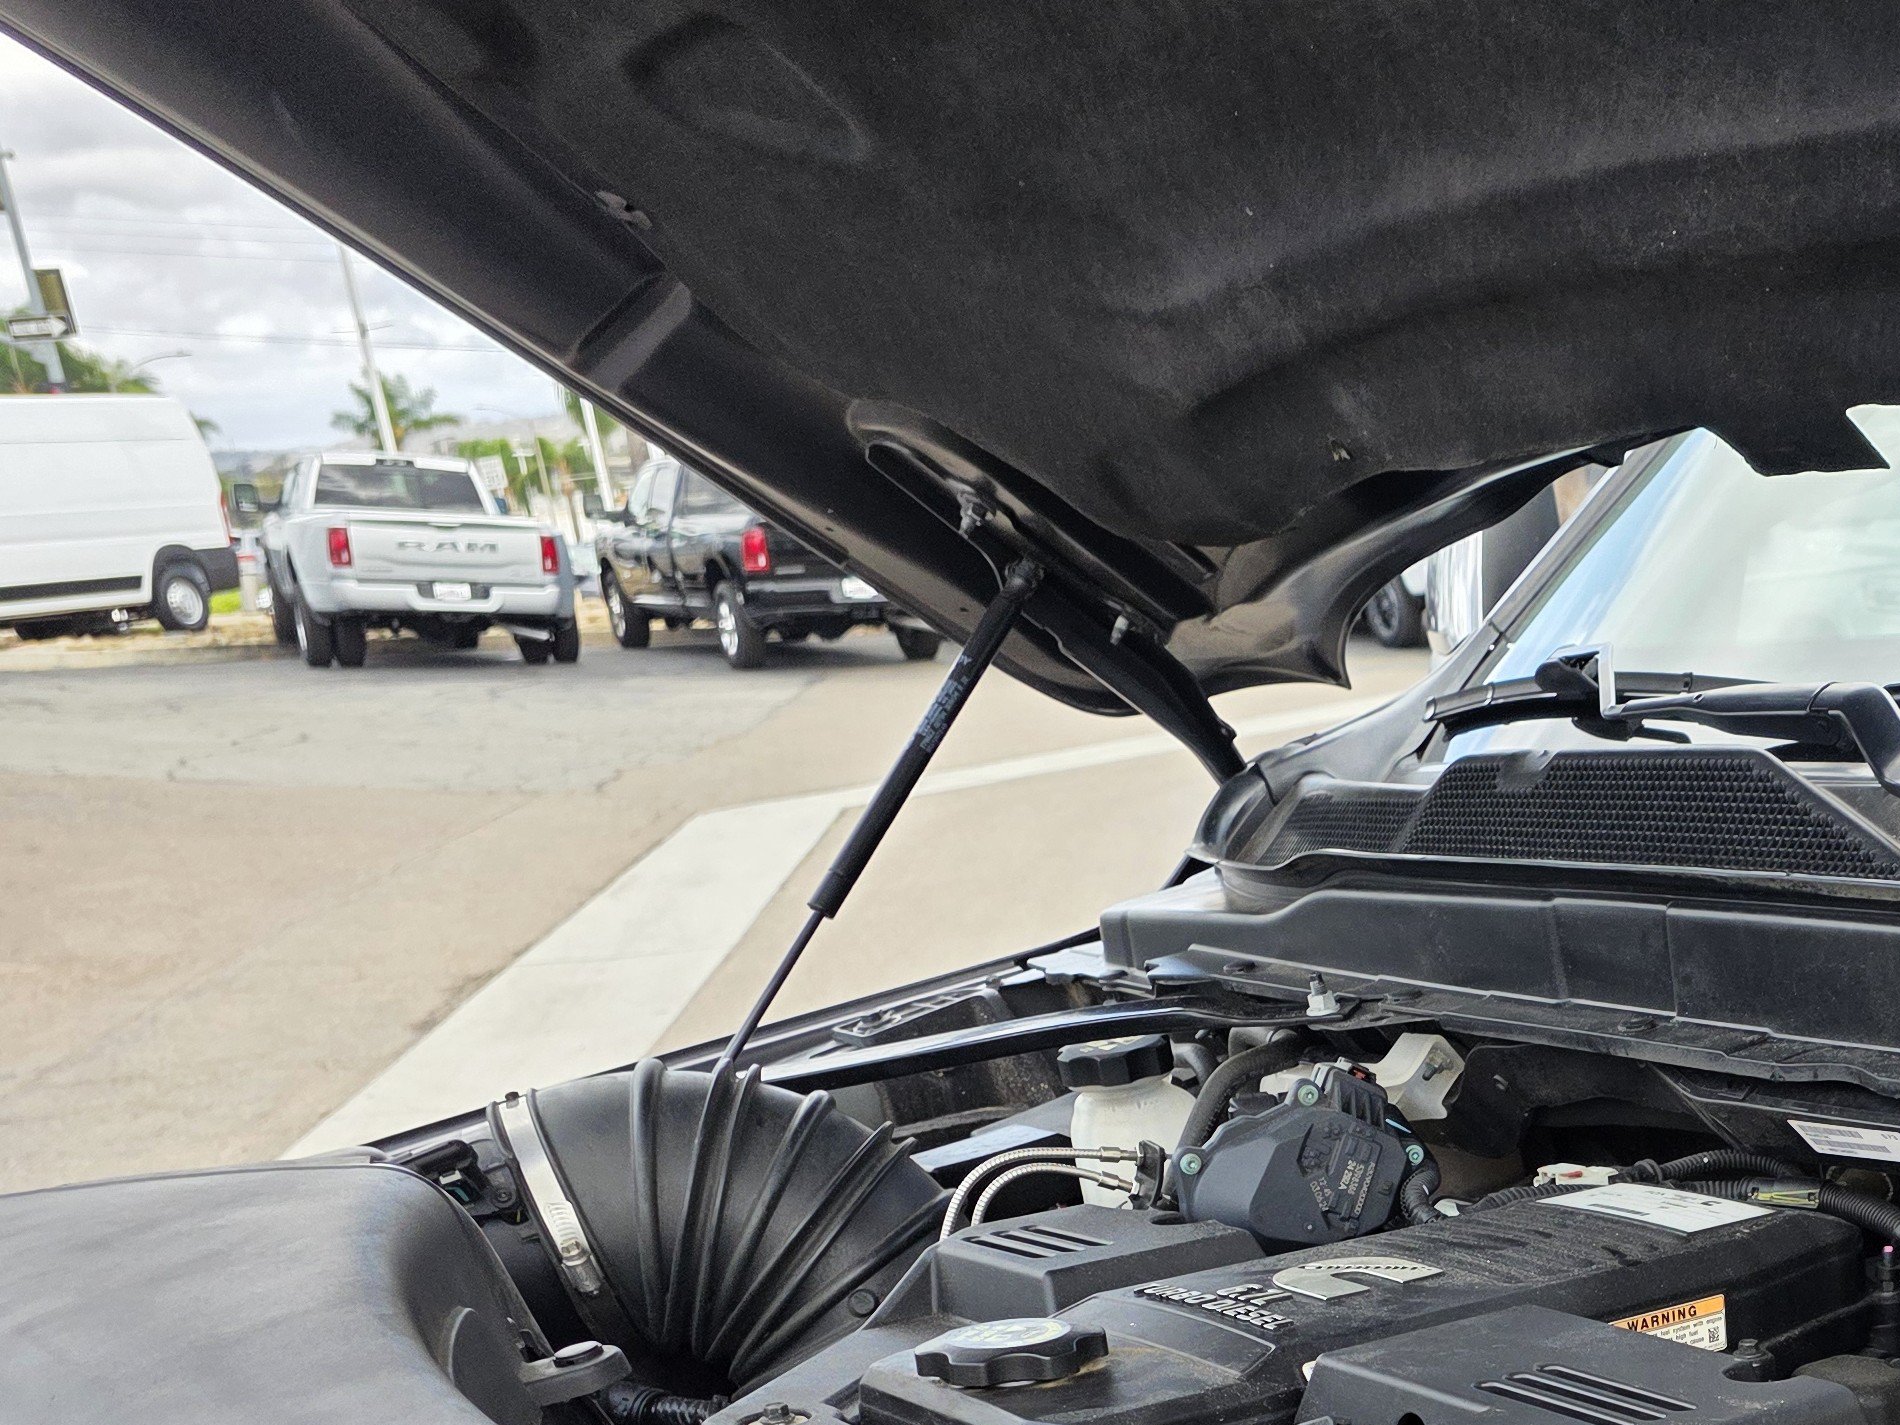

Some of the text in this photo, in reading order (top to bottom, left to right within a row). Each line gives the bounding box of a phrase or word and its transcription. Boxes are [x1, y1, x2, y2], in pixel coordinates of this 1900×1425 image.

[398, 541, 498, 552] RAM
[1133, 1283, 1295, 1330] TURBO DIESEL
[1627, 1305, 1698, 1332] WARNING
